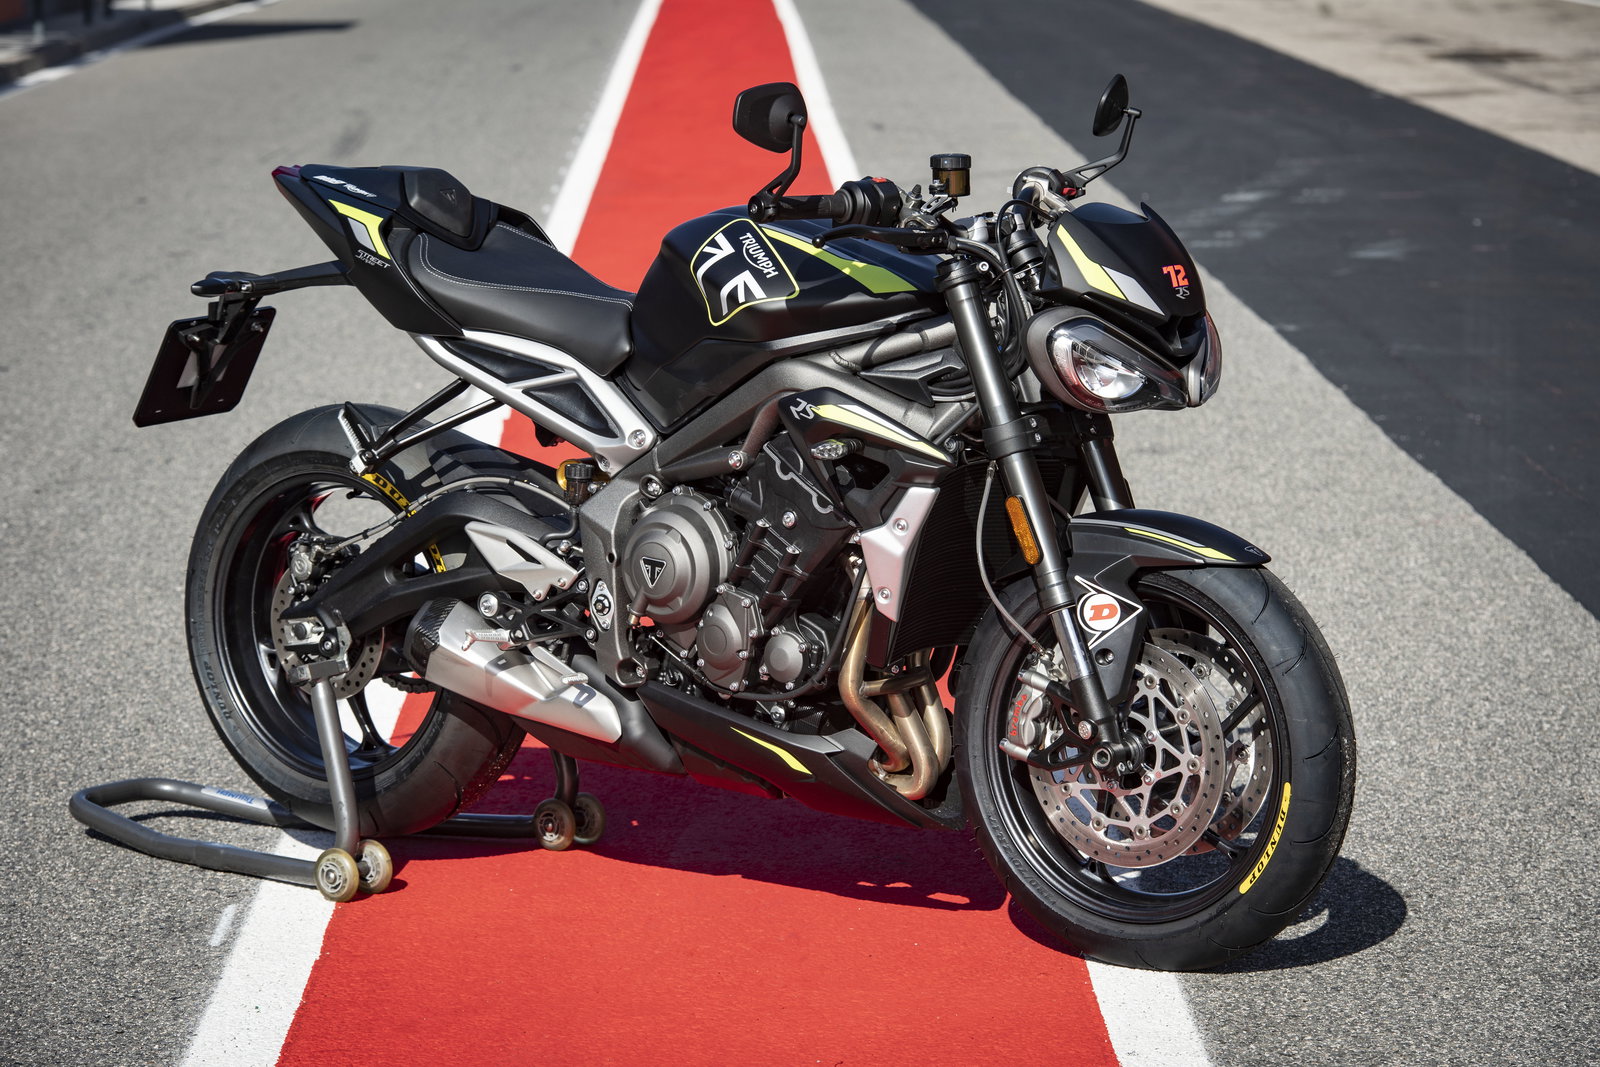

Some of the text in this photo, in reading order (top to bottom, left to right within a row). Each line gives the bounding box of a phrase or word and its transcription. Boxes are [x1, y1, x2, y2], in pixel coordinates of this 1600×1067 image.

[358, 249, 391, 268] STREET
[739, 232, 779, 278] TRIUMPH
[1162, 265, 1189, 288] 72
[1174, 286, 1190, 299] RS
[789, 398, 820, 420] RS
[1009, 694, 1028, 736] brembo
[1249, 807, 1286, 885] DUNLOP
